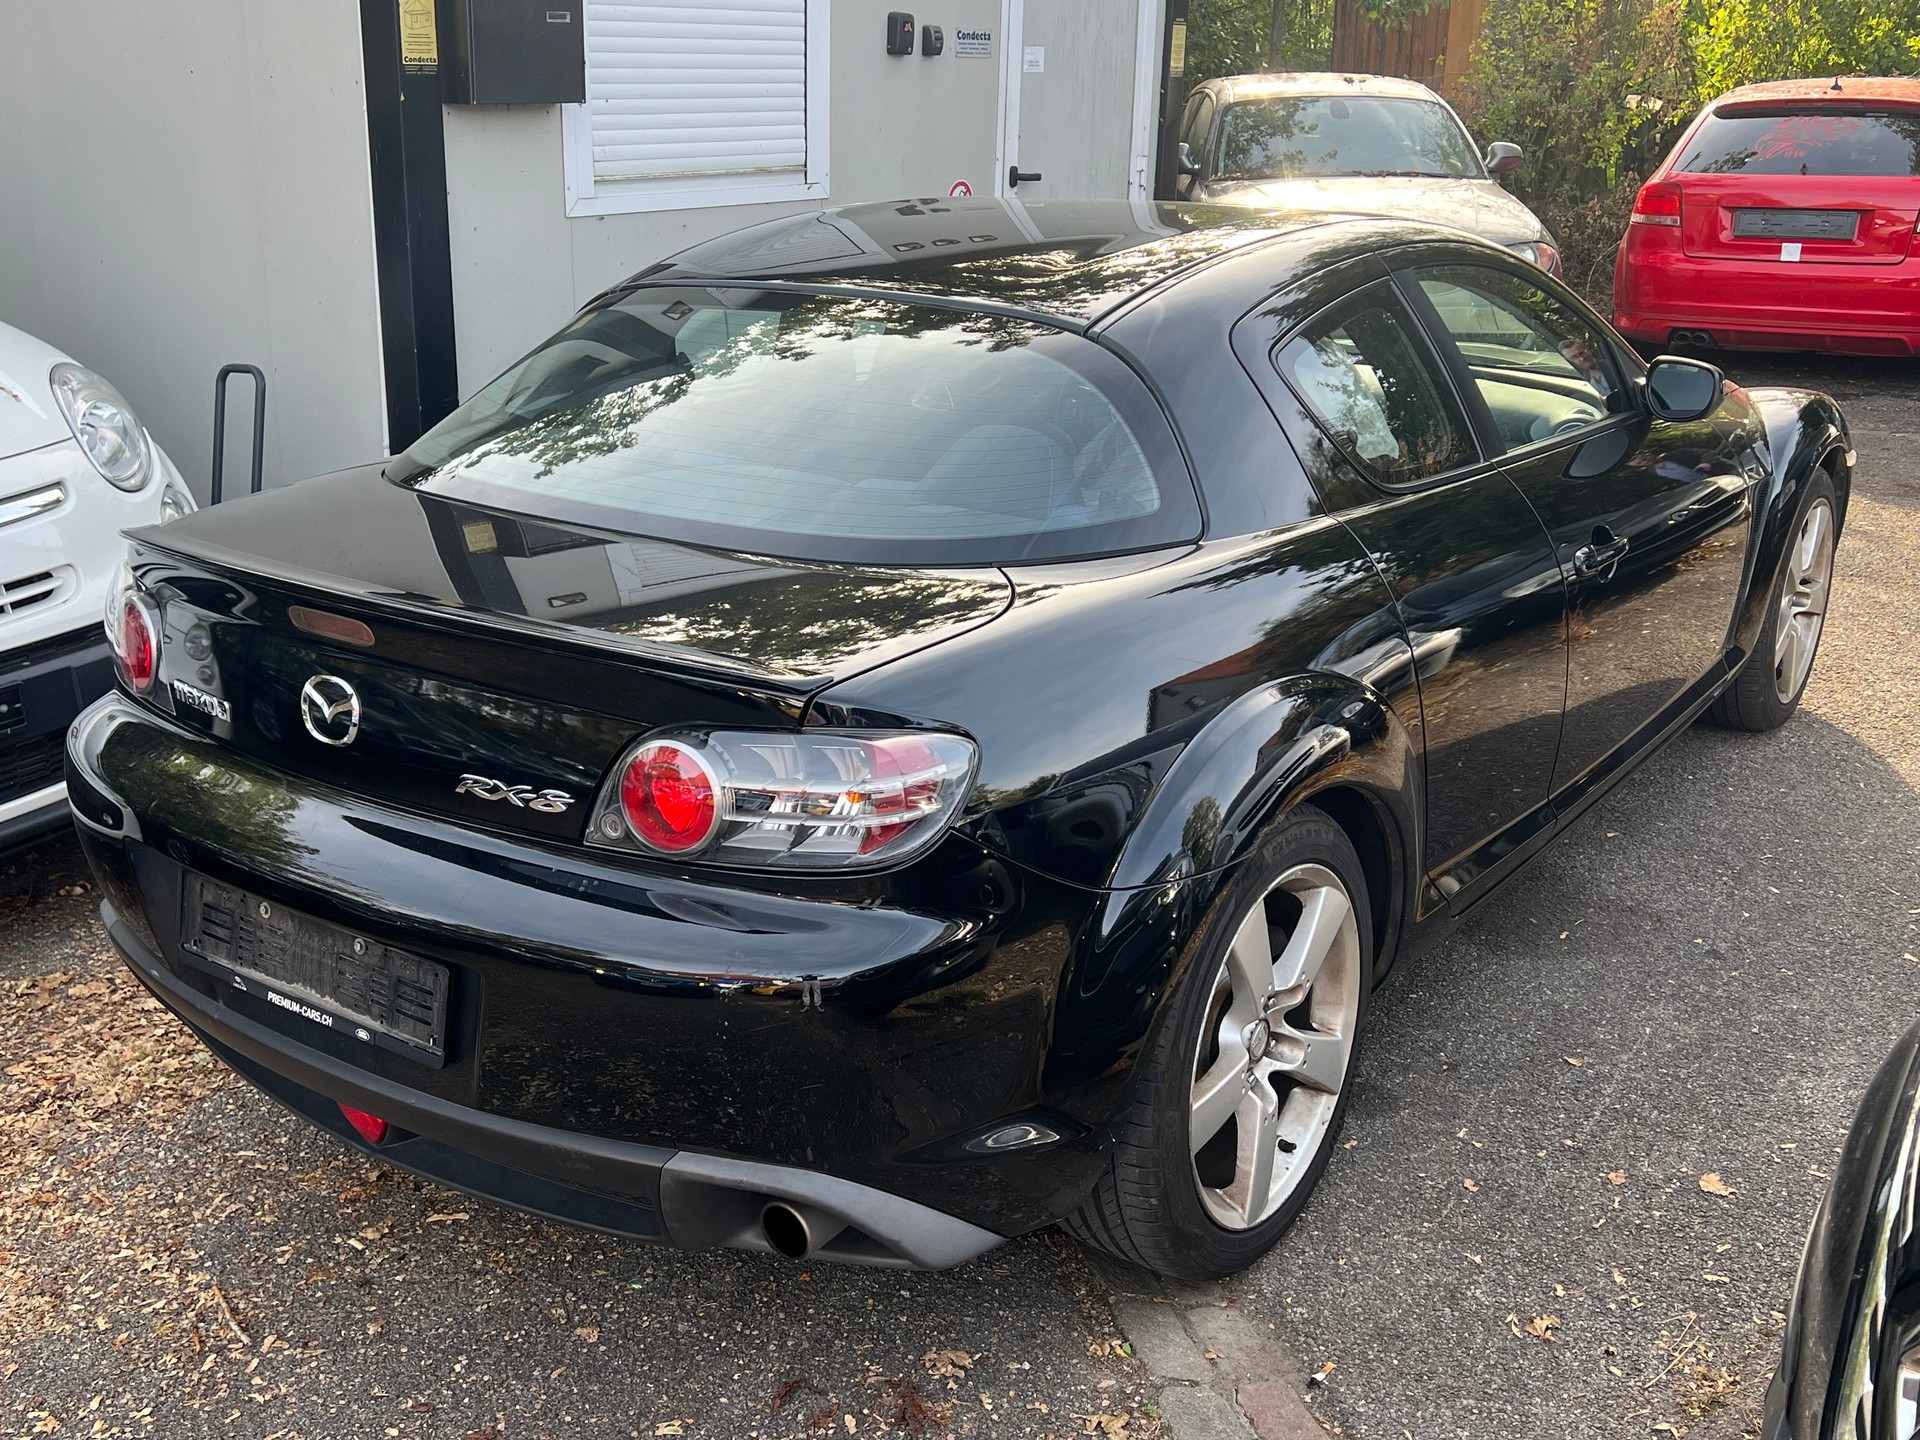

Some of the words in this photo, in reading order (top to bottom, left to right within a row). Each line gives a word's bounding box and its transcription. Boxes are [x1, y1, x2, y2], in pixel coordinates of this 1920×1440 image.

[957, 30, 991, 41] Condecta
[404, 56, 437, 64] Condecta
[455, 774, 576, 813] RX-8
[267, 991, 333, 1028] PREMIUM-CARS.CH
